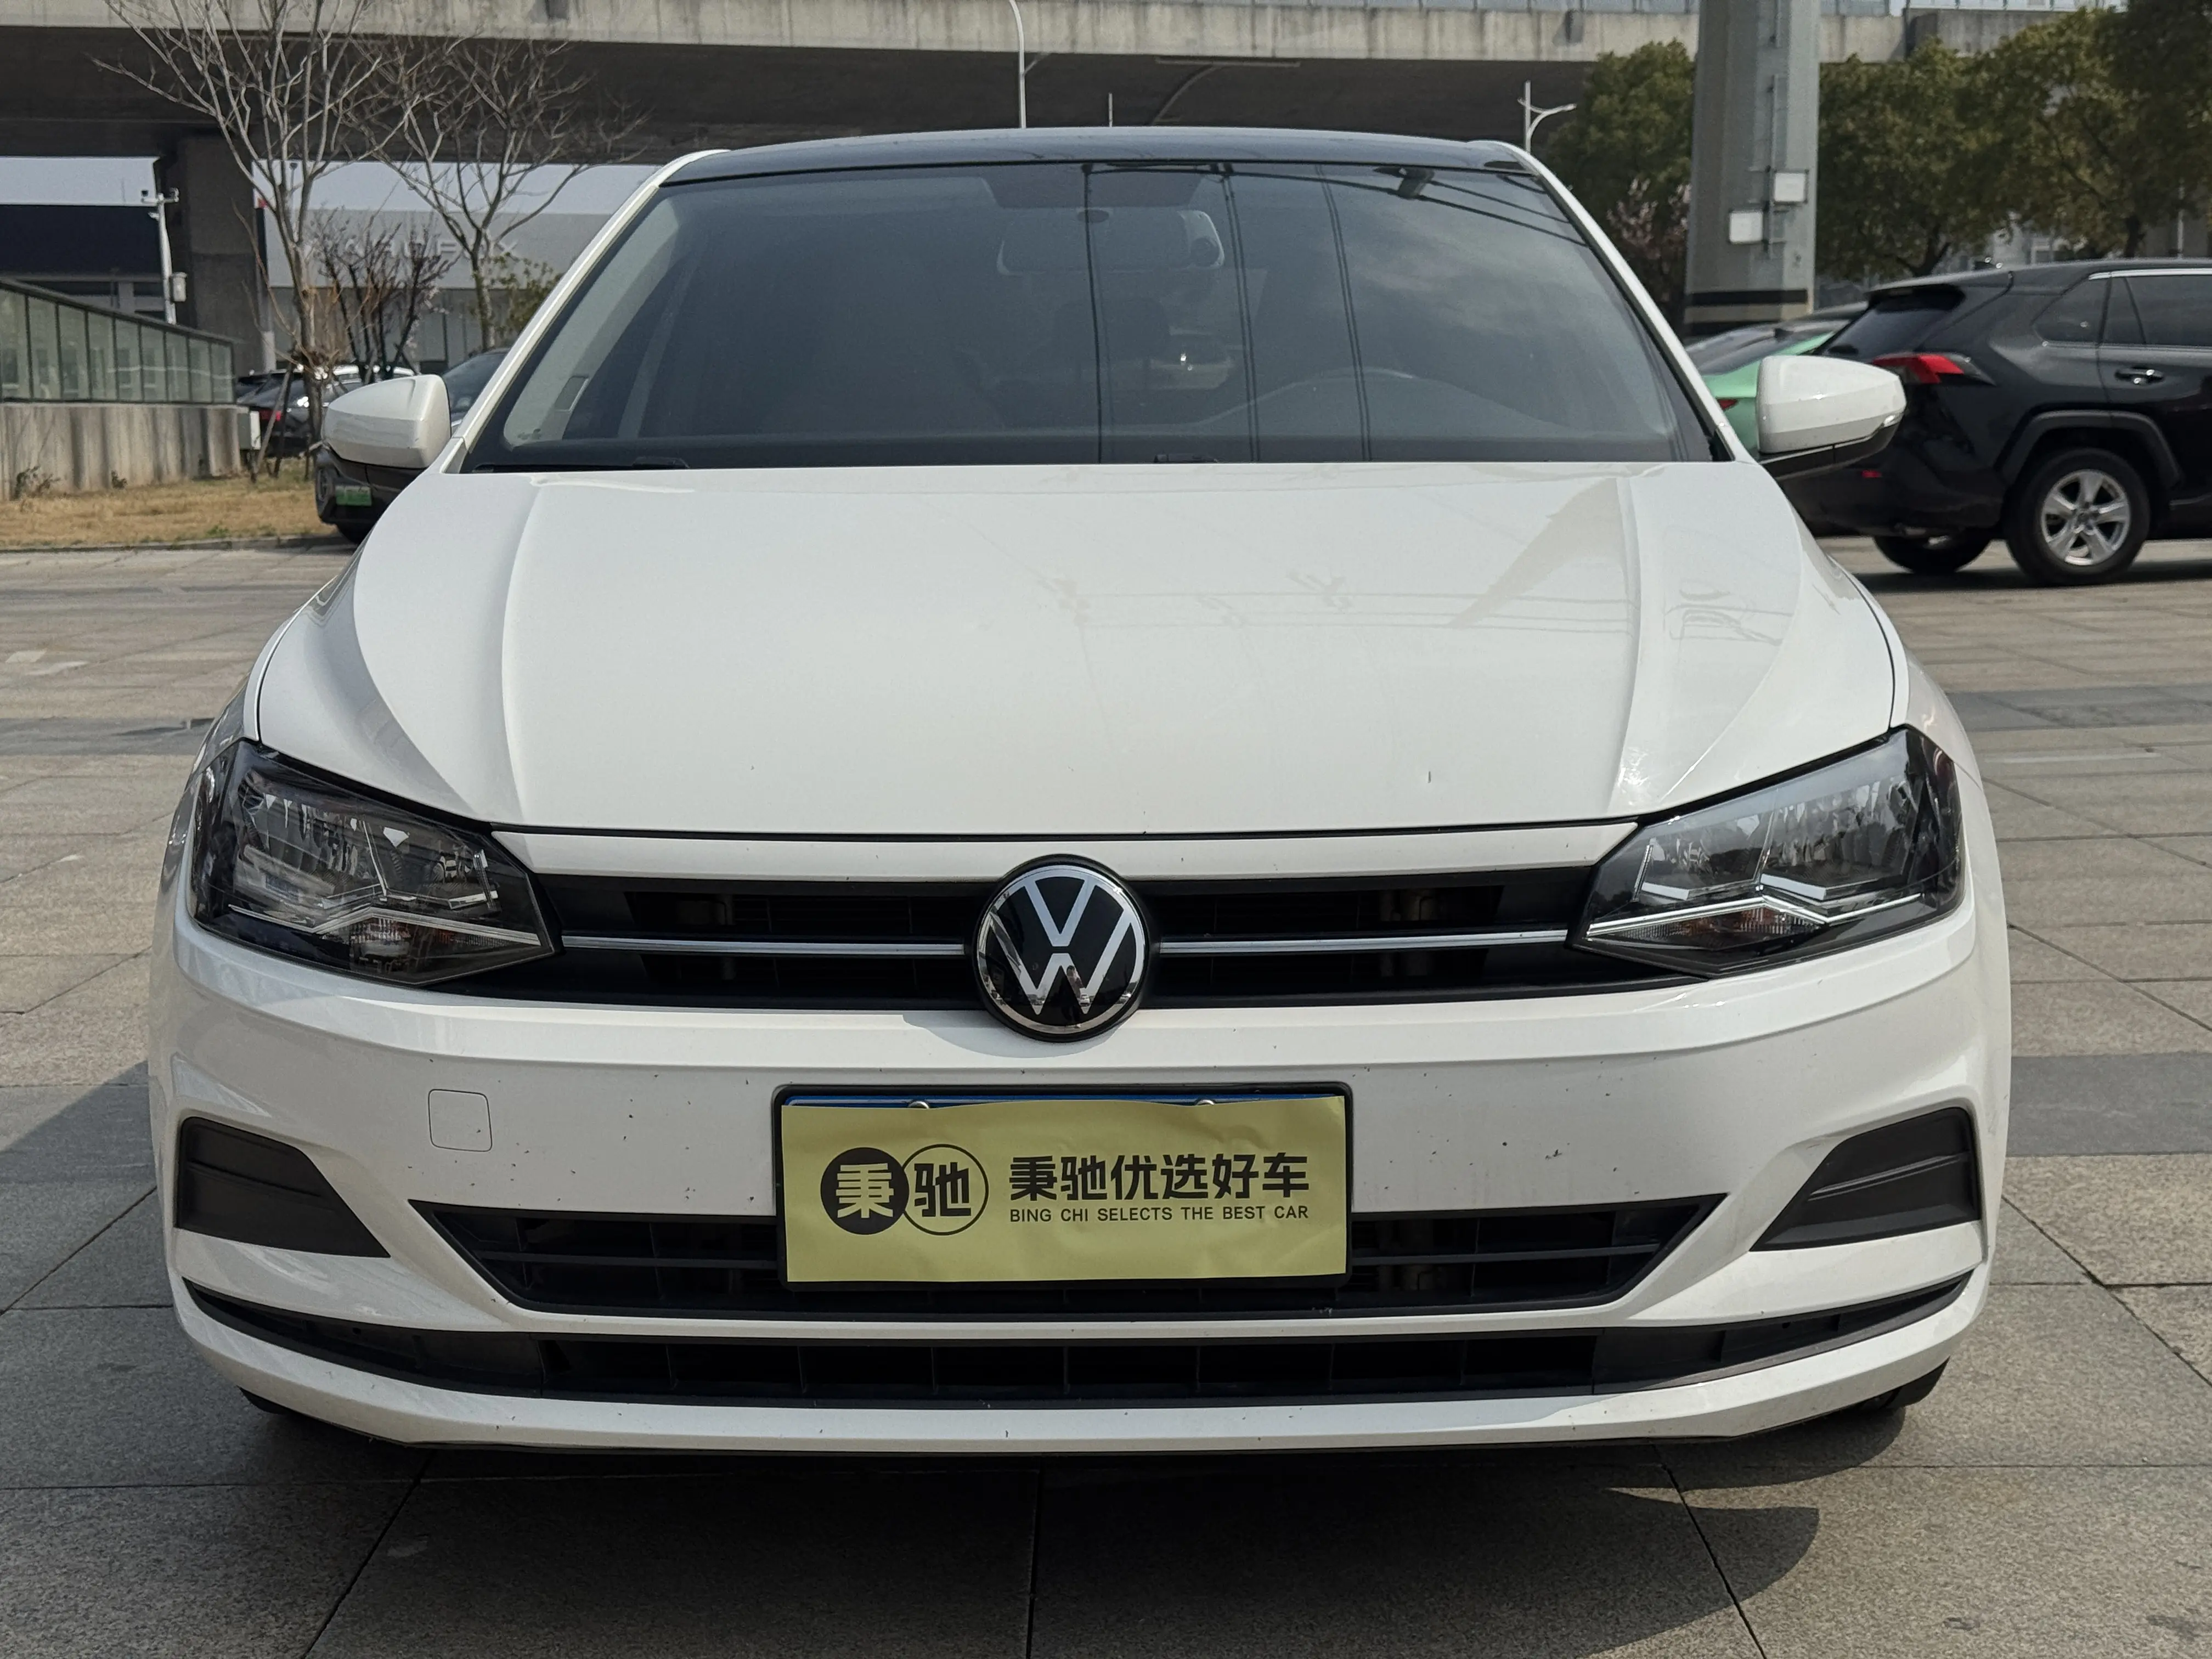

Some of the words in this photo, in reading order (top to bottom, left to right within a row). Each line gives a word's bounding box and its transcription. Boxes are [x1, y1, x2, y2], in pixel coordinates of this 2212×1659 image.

[836, 1161, 972, 1218] 秉驰
[1009, 1152, 1310, 1201] 秉驰优选好车
[1010, 1209, 1052, 1222] BING
[1060, 1209, 1088, 1222] CHI
[1098, 1207, 1172, 1221] SELECTS
[1181, 1206, 1214, 1220] THE
[1223, 1206, 1266, 1220] BEST
[1274, 1205, 1309, 1219] CAR
